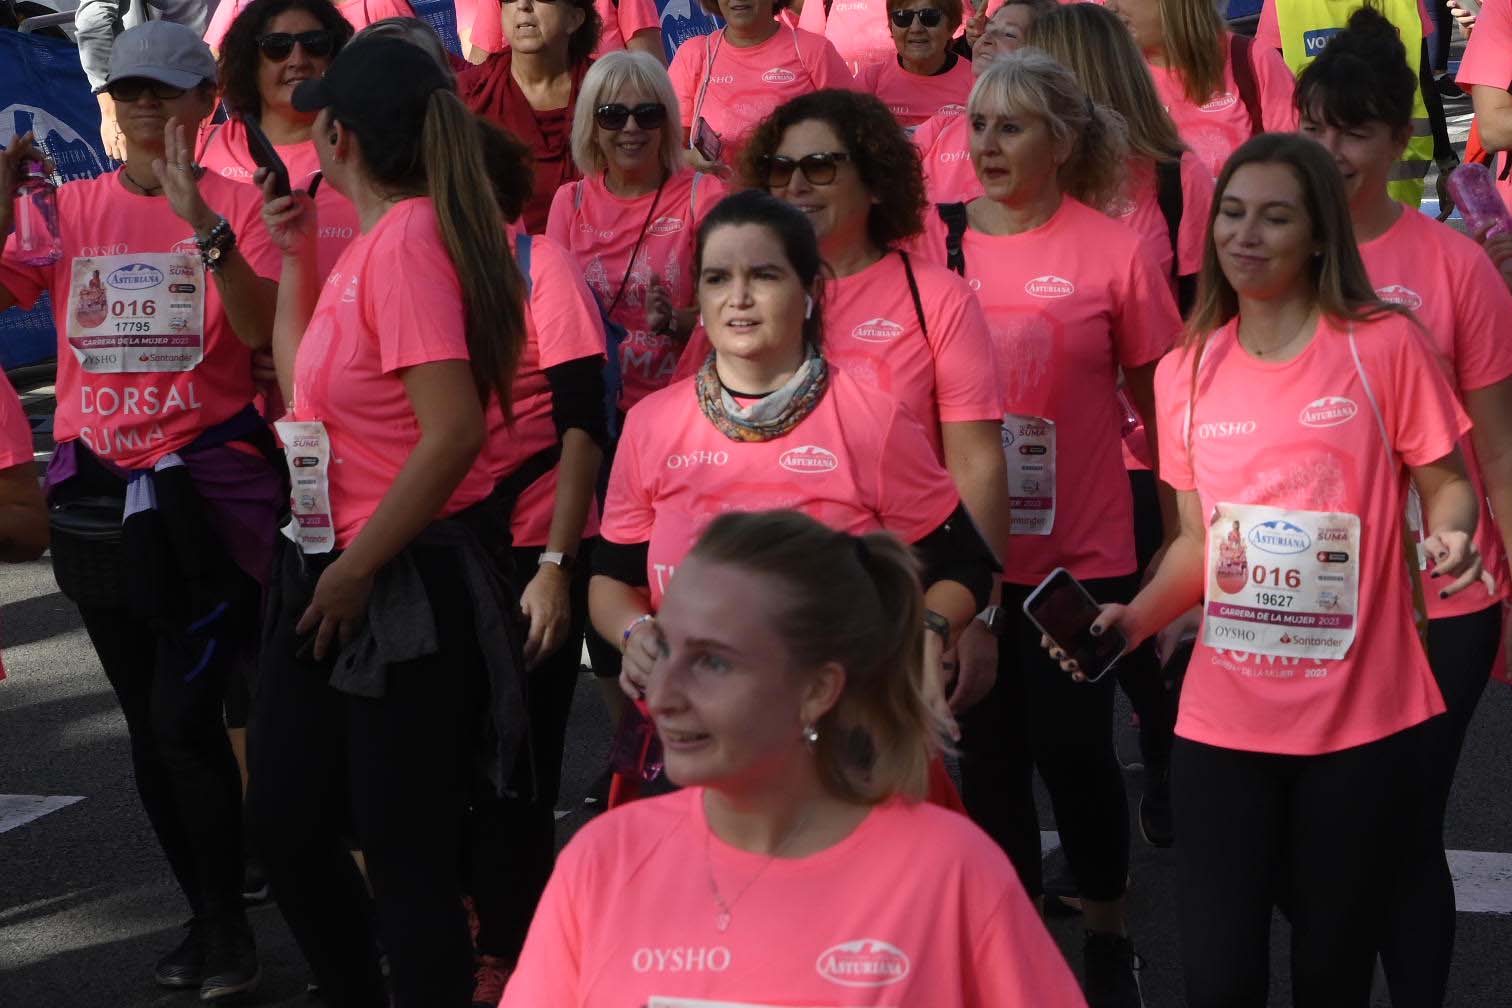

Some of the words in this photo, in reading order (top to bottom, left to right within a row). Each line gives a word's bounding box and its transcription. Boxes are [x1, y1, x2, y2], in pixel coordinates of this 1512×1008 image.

[112, 273, 159, 285] ASTURIANA
[169, 268, 195, 277] SUMA
[1031, 283, 1073, 294] ASTURIANA
[112, 300, 156, 317] 016
[115, 322, 150, 332] 17795
[150, 353, 192, 362] Santander
[81, 383, 202, 416] DORSAL
[1304, 405, 1354, 424] ASTURIANA
[80, 424, 164, 454] SUMA
[1199, 420, 1256, 440] OYSHO
[667, 450, 728, 470] OYSHO
[783, 456, 834, 469] ASTURIANA
[1253, 531, 1306, 549] ASTURIANA
[1317, 533, 1348, 542] SUMA
[1252, 565, 1301, 589] 016
[1255, 593, 1293, 608] 19627
[1220, 607, 1255, 621] CARRERA
[1257, 610, 1269, 622] DE
[1270, 612, 1282, 622] LA
[1284, 613, 1316, 625] MUJER
[1215, 625, 1256, 642] OYSHO
[1292, 634, 1344, 648] Santander
[632, 946, 731, 974] OYSHO
[825, 954, 901, 975] ASTURIANA
